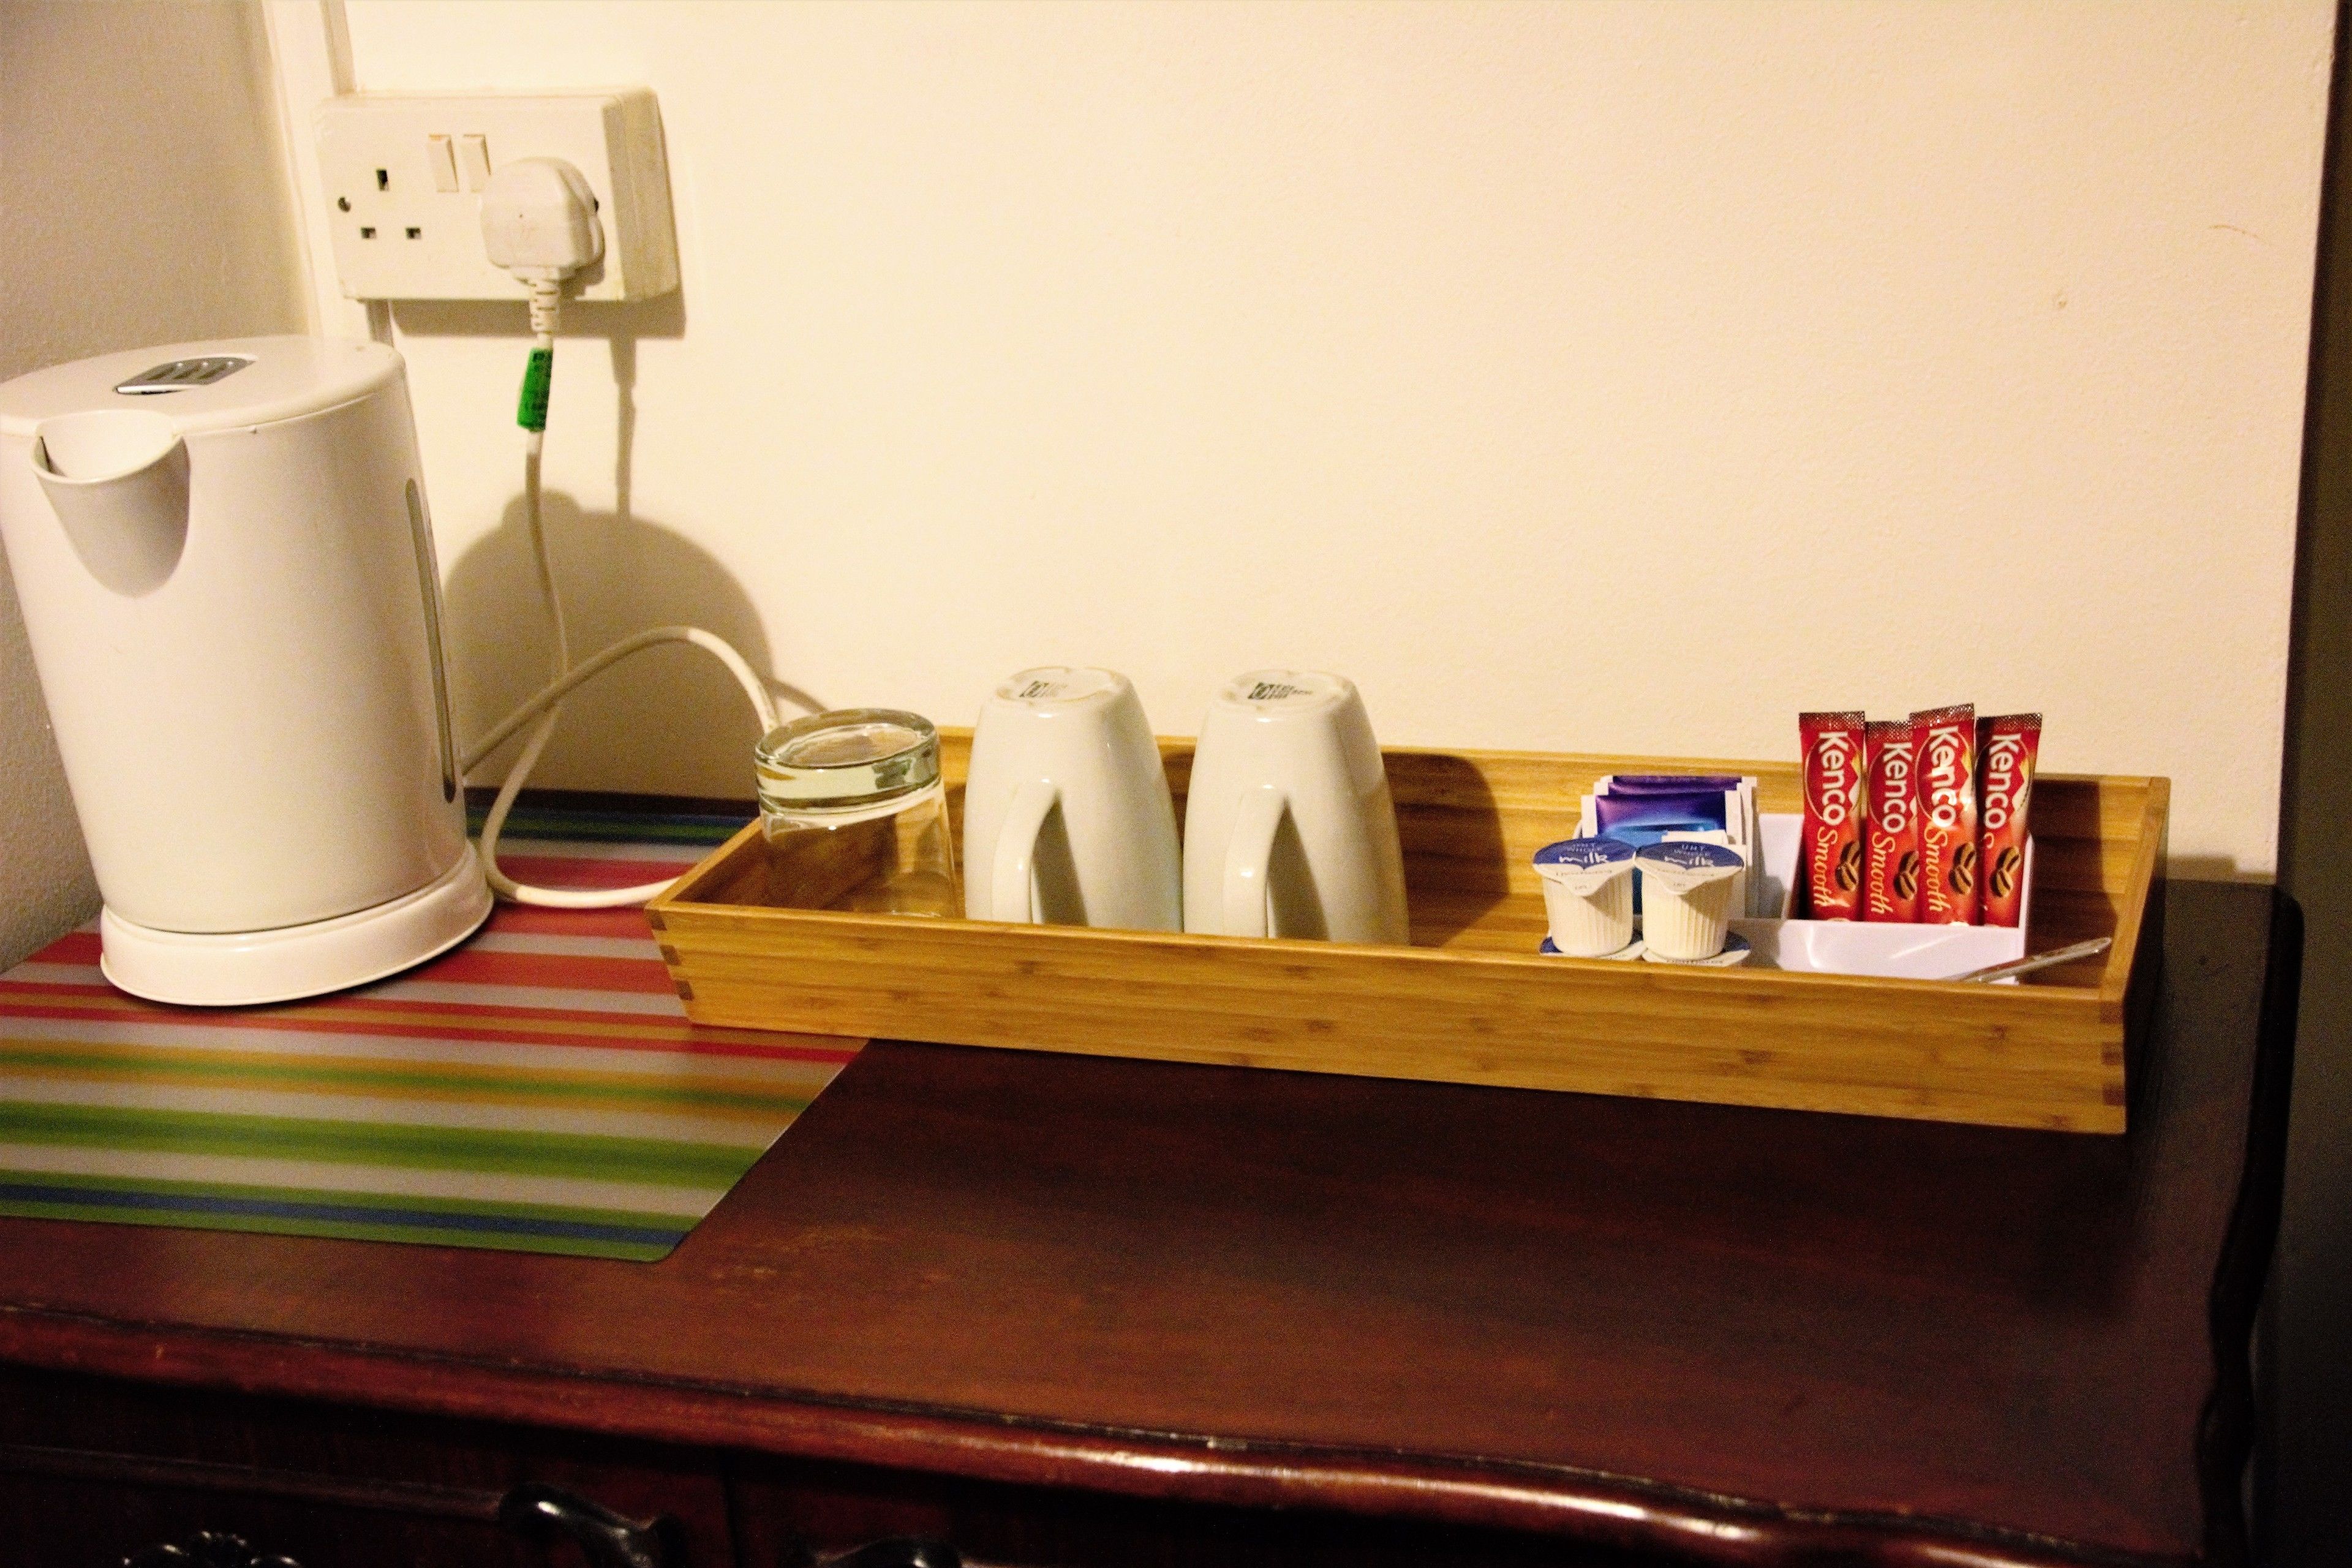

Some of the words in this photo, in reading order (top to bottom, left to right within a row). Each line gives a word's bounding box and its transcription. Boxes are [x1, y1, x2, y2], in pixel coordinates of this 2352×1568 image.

[1819, 732, 1849, 826] Kenco
[1882, 742, 1912, 834] Kenco
[1929, 726, 1959, 827] Kenco
[1984, 733, 2021, 829] Kenco
[1559, 852, 1608, 863] milk
[1664, 856, 1714, 867] milk
[1814, 826, 1838, 907] Smooth
[1870, 832, 1896, 914] Smooth
[1924, 825, 1951, 911] Smooth
